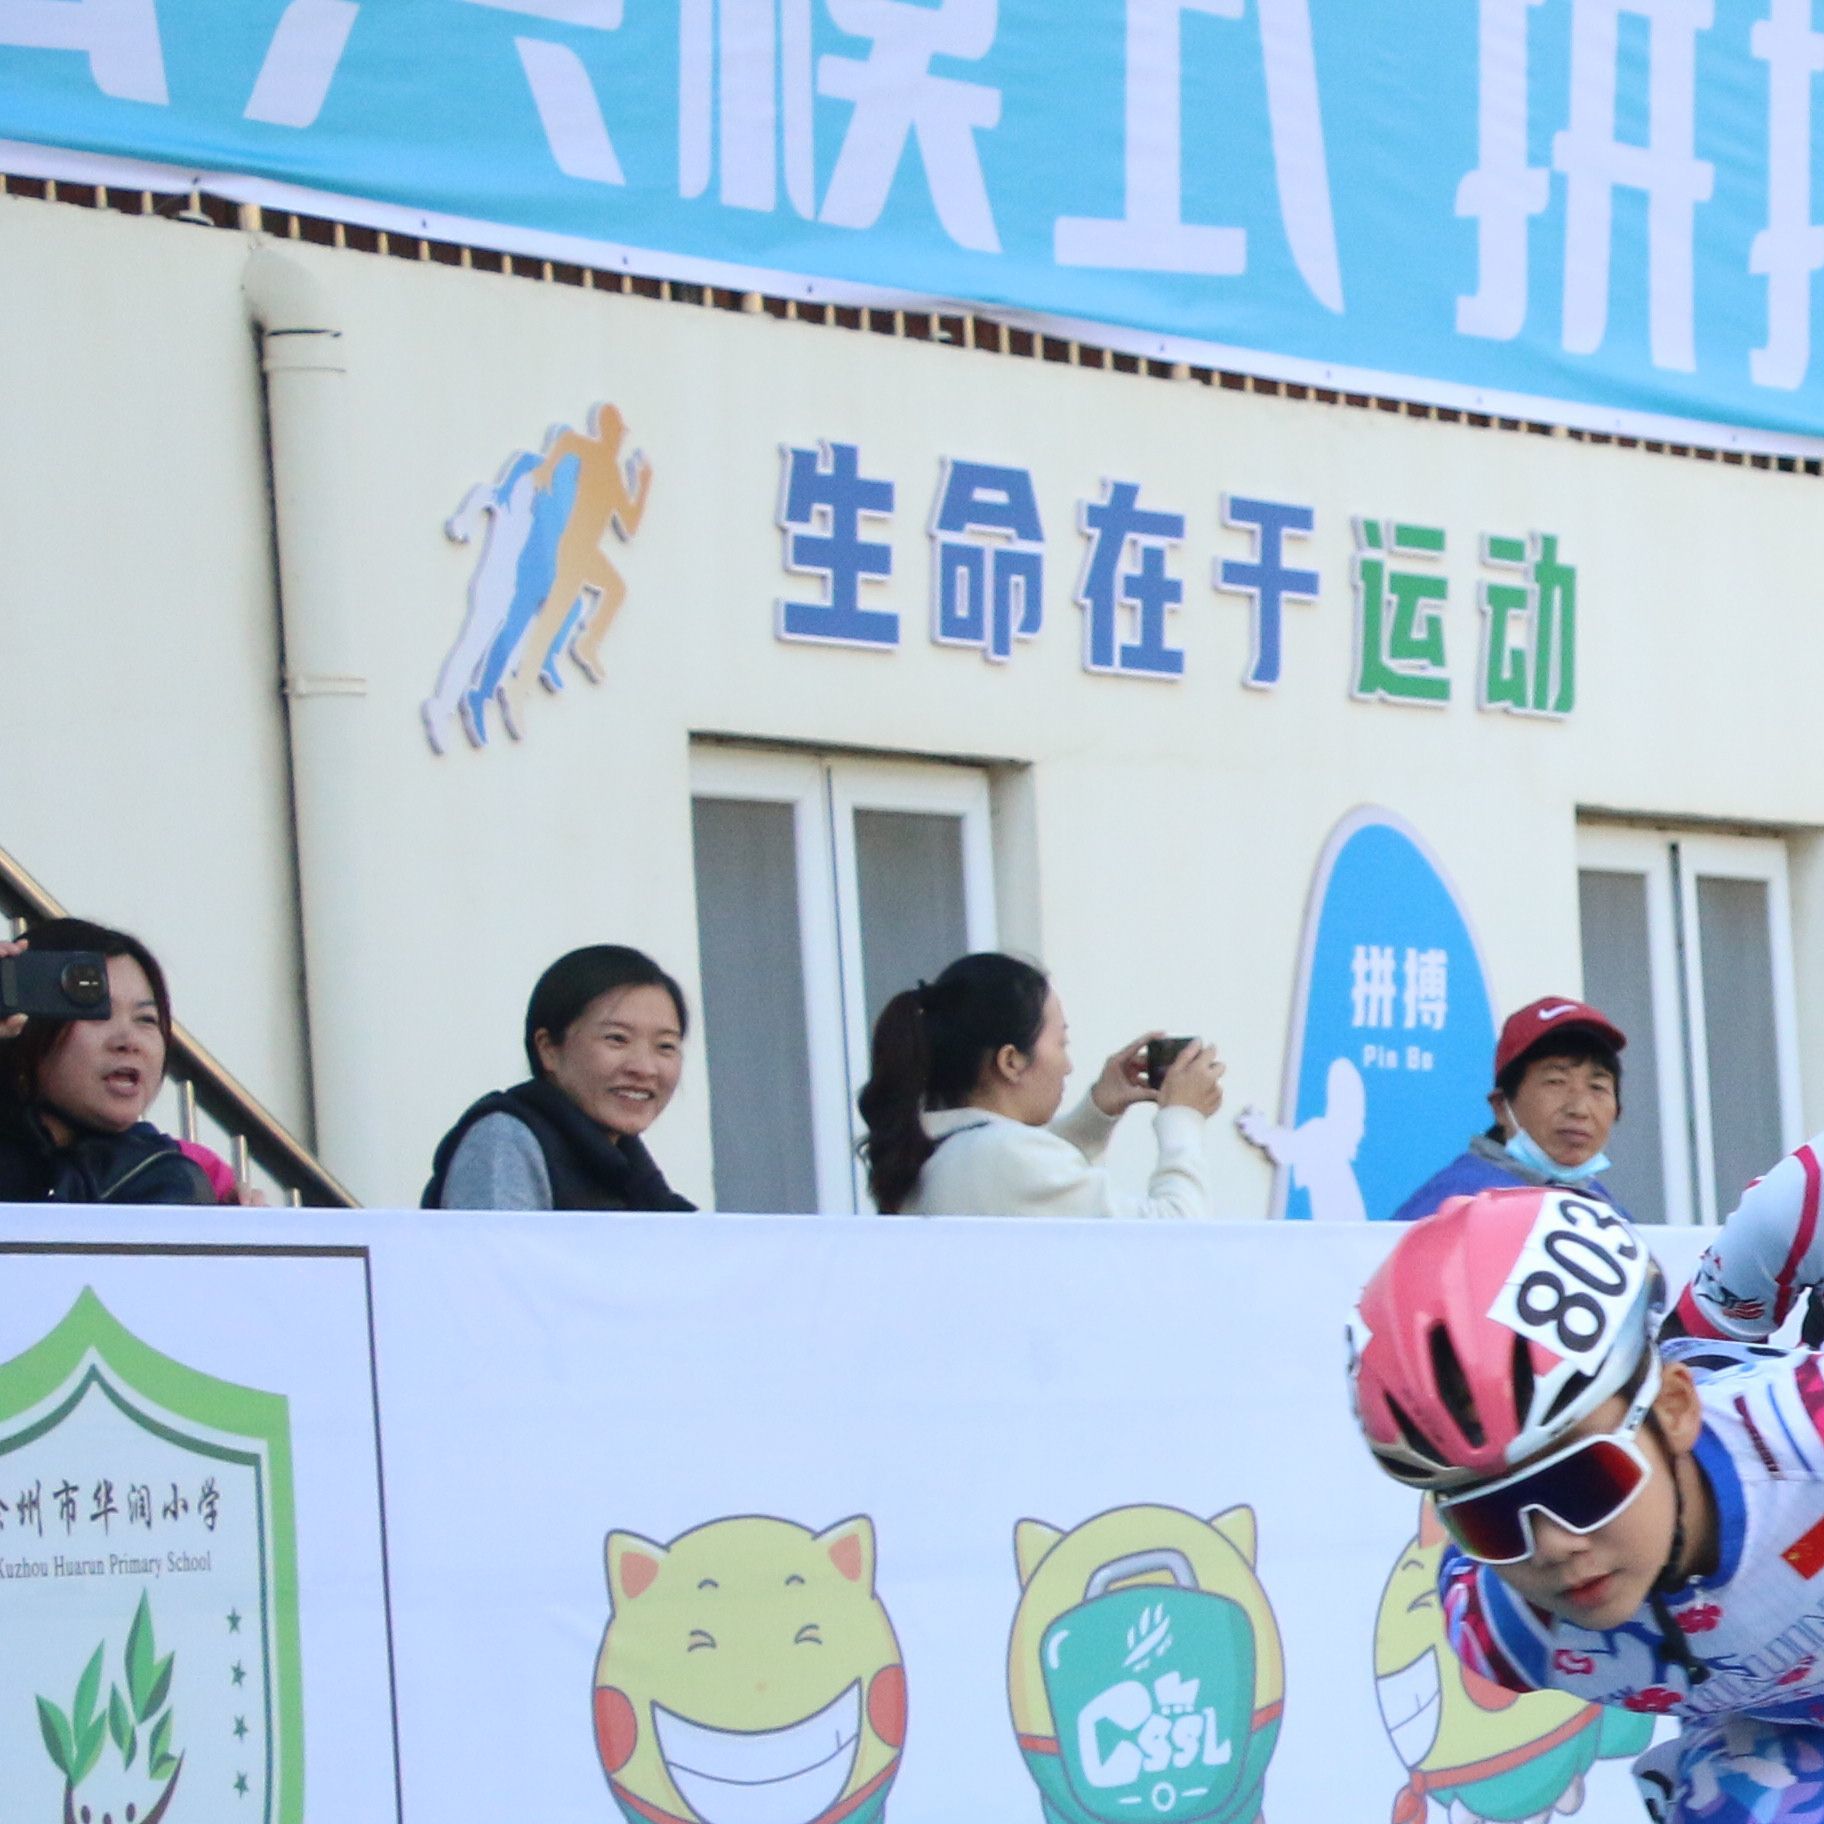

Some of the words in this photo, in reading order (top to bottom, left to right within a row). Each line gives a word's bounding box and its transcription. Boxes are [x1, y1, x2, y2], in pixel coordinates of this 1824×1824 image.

[778, 442, 1577, 717] 生命在于运动
[1350, 945, 1448, 1030] 拼搏
[1518, 1199, 1638, 1353] 803
[0, 1476, 220, 1538] 州市华润小学
[54, 1555, 104, 1577] Huarun
[110, 1551, 161, 1579] Primary
[167, 1550, 212, 1573] School
